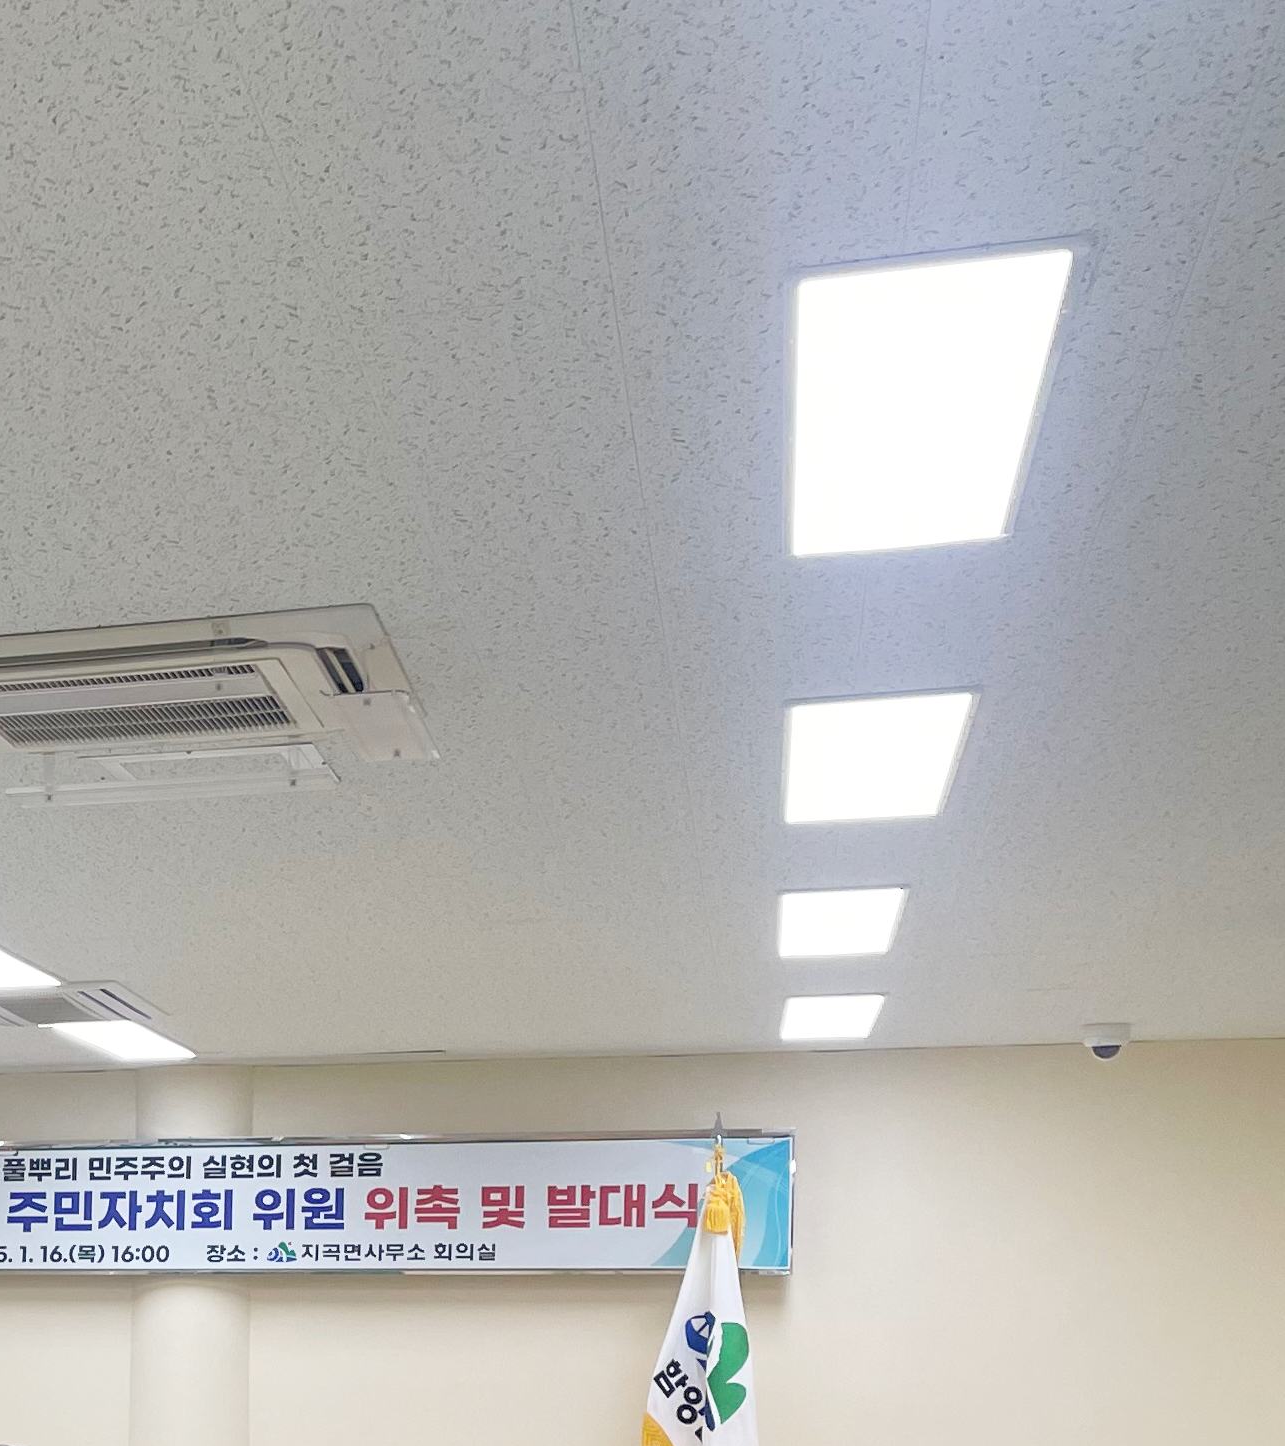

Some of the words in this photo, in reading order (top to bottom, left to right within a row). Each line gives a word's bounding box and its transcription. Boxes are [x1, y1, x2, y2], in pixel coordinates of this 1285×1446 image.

[2, 1157, 78, 1181] 풀뿌리
[88, 1155, 192, 1180] 민주주의
[202, 1153, 282, 1179] 실현의
[292, 1153, 319, 1178] 첫
[328, 1152, 384, 1178] 걸음
[6, 1188, 234, 1232] 주민자치회
[252, 1187, 345, 1231] 위원
[364, 1184, 459, 1231] 위촉
[480, 1183, 527, 1230] 및
[546, 1183, 700, 1229] 발대식
[111, 1245, 170, 1263] 16:00
[301, 1243, 426, 1262] 지곡면사무소
[433, 1242, 497, 1262] 회의실
